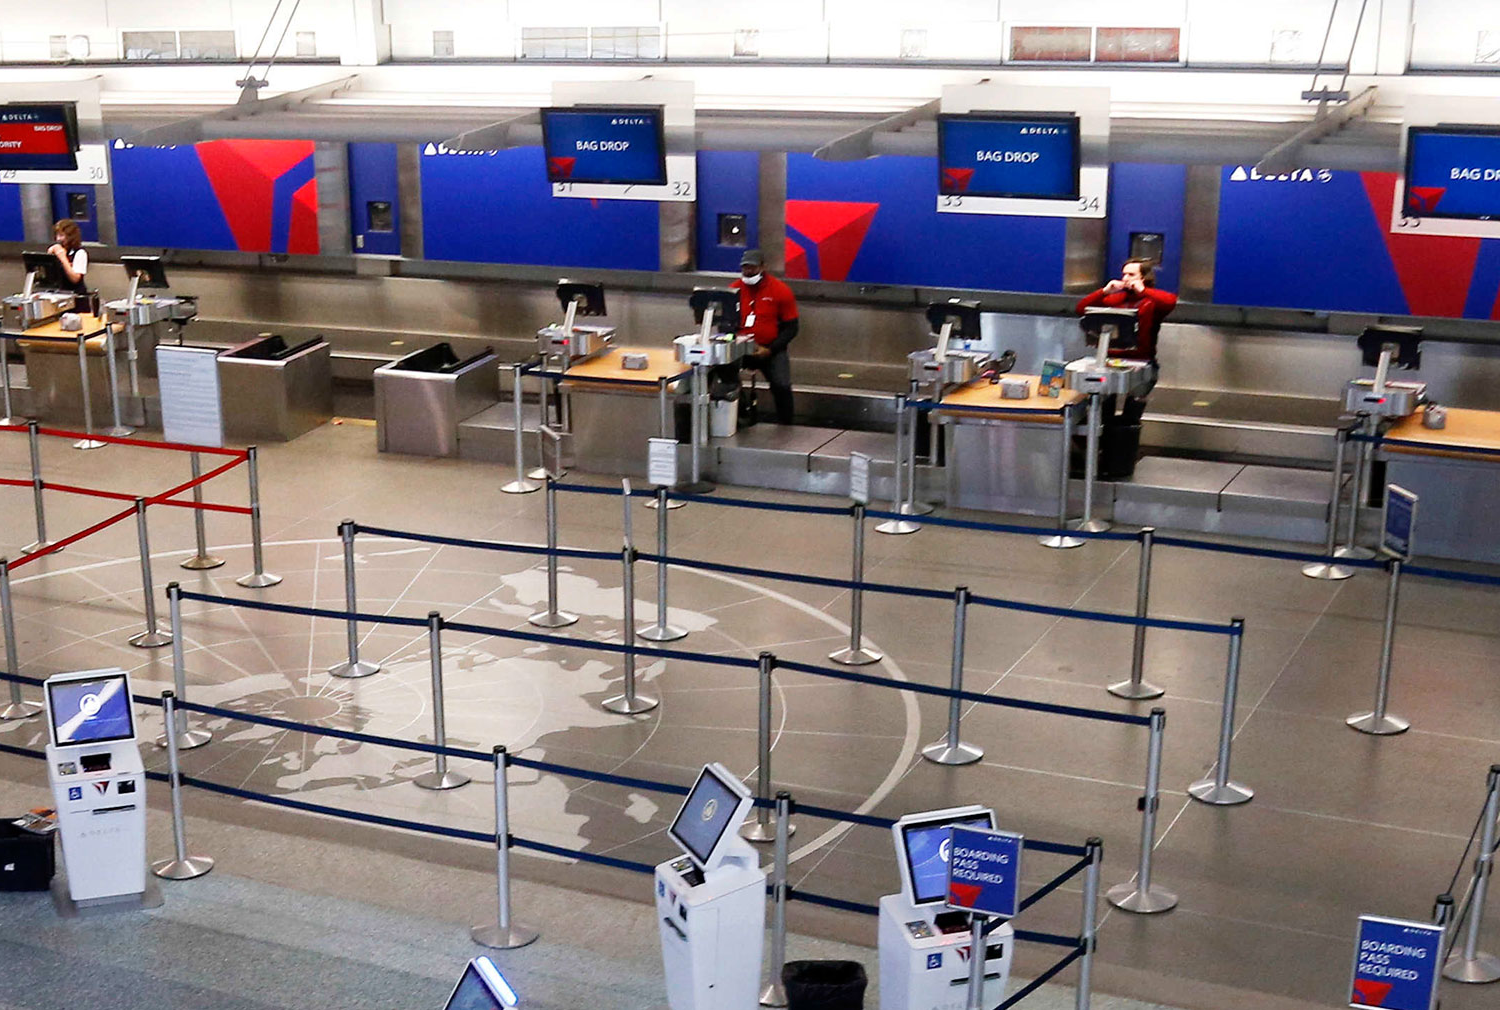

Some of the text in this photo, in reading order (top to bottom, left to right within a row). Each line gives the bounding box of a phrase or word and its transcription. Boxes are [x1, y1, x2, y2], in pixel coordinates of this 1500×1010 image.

[1029, 127, 1059, 135] DELTA
[576, 140, 629, 152] BAG DROP
[976, 150, 1040, 163] BAG DROP
[88, 167, 103, 180] 30
[1450, 167, 1482, 180] BAG
[672, 181, 691, 196] 32
[1077, 196, 1100, 212] 34
[953, 847, 1010, 865] BOARDING
[952, 857, 979, 870] PASS
[952, 867, 1004, 884] REQUIRED
[1360, 939, 1427, 959] BOARDING
[1359, 952, 1391, 965] PASS
[1358, 963, 1420, 981] REQUIRED
